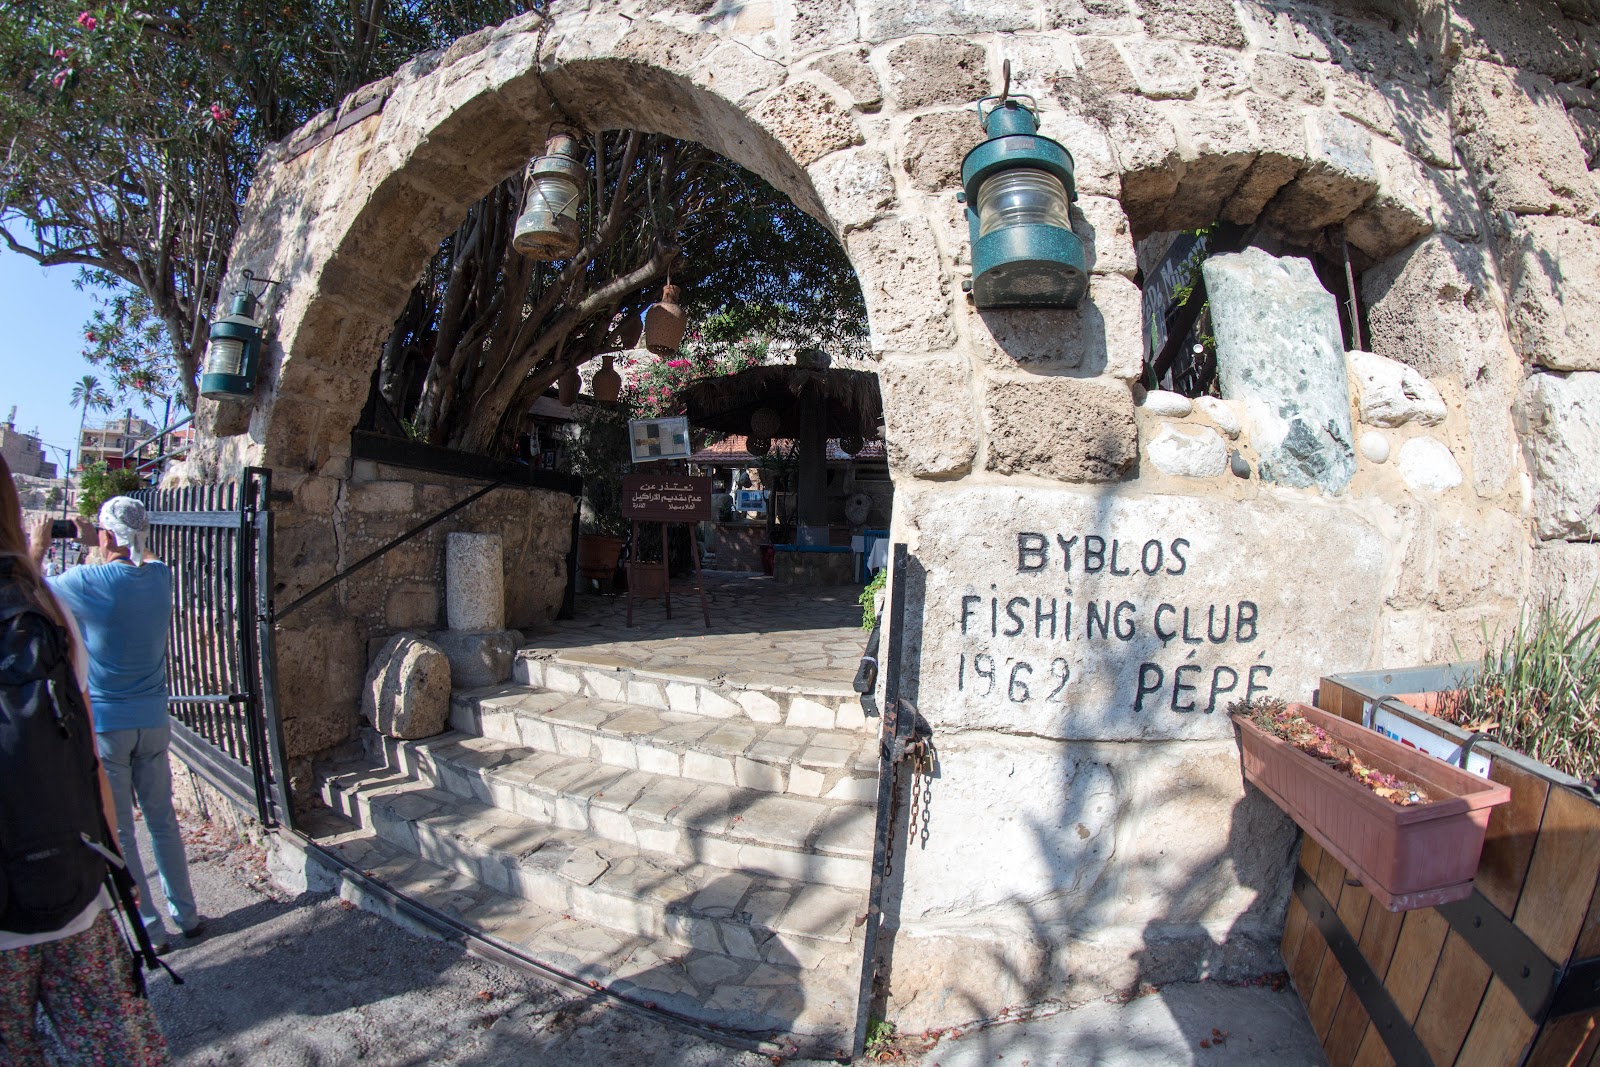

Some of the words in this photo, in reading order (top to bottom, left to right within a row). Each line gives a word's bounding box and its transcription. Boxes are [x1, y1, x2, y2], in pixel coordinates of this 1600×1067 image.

[658, 482, 694, 491] نعتذر
[661, 493, 687, 502] تقديم
[688, 494, 702, 503] عدم
[1017, 532, 1190, 576] BYBLOS
[1153, 601, 1258, 647] CLUB
[958, 653, 1070, 703] 1969
[1133, 649, 1273, 713] PÉPÉ
